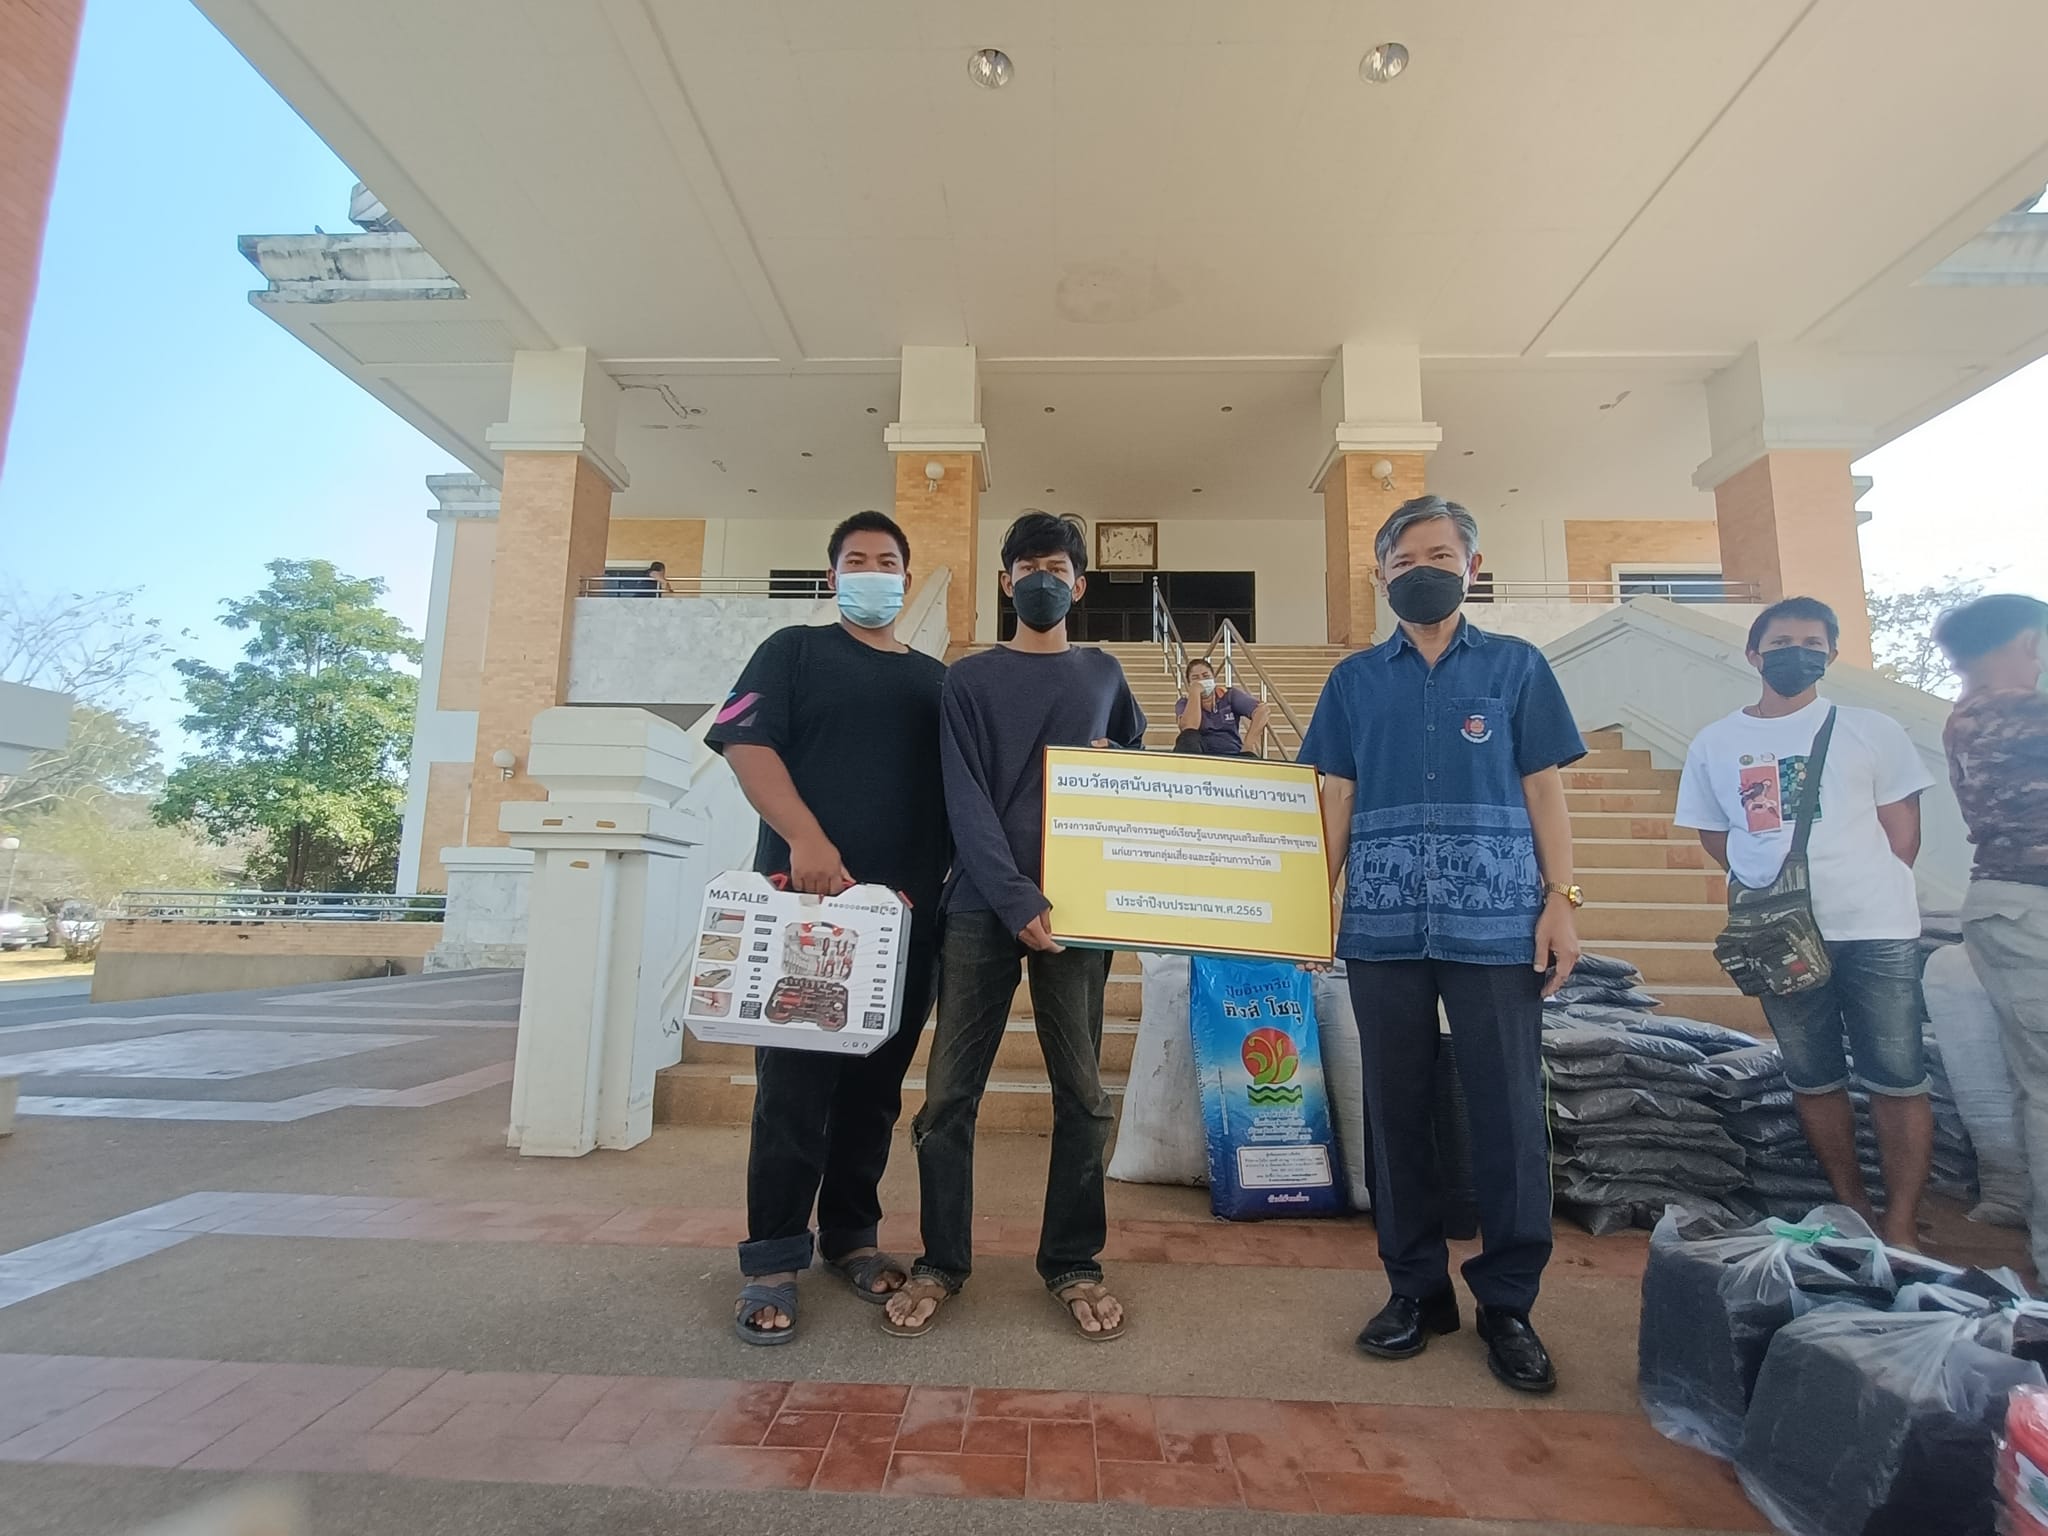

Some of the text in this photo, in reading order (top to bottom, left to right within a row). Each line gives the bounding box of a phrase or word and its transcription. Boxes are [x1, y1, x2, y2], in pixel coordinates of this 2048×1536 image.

[1057, 773, 1306, 804] มอบวัสดุสนับสนุนอาชีพแก่เยาวชนฯ
